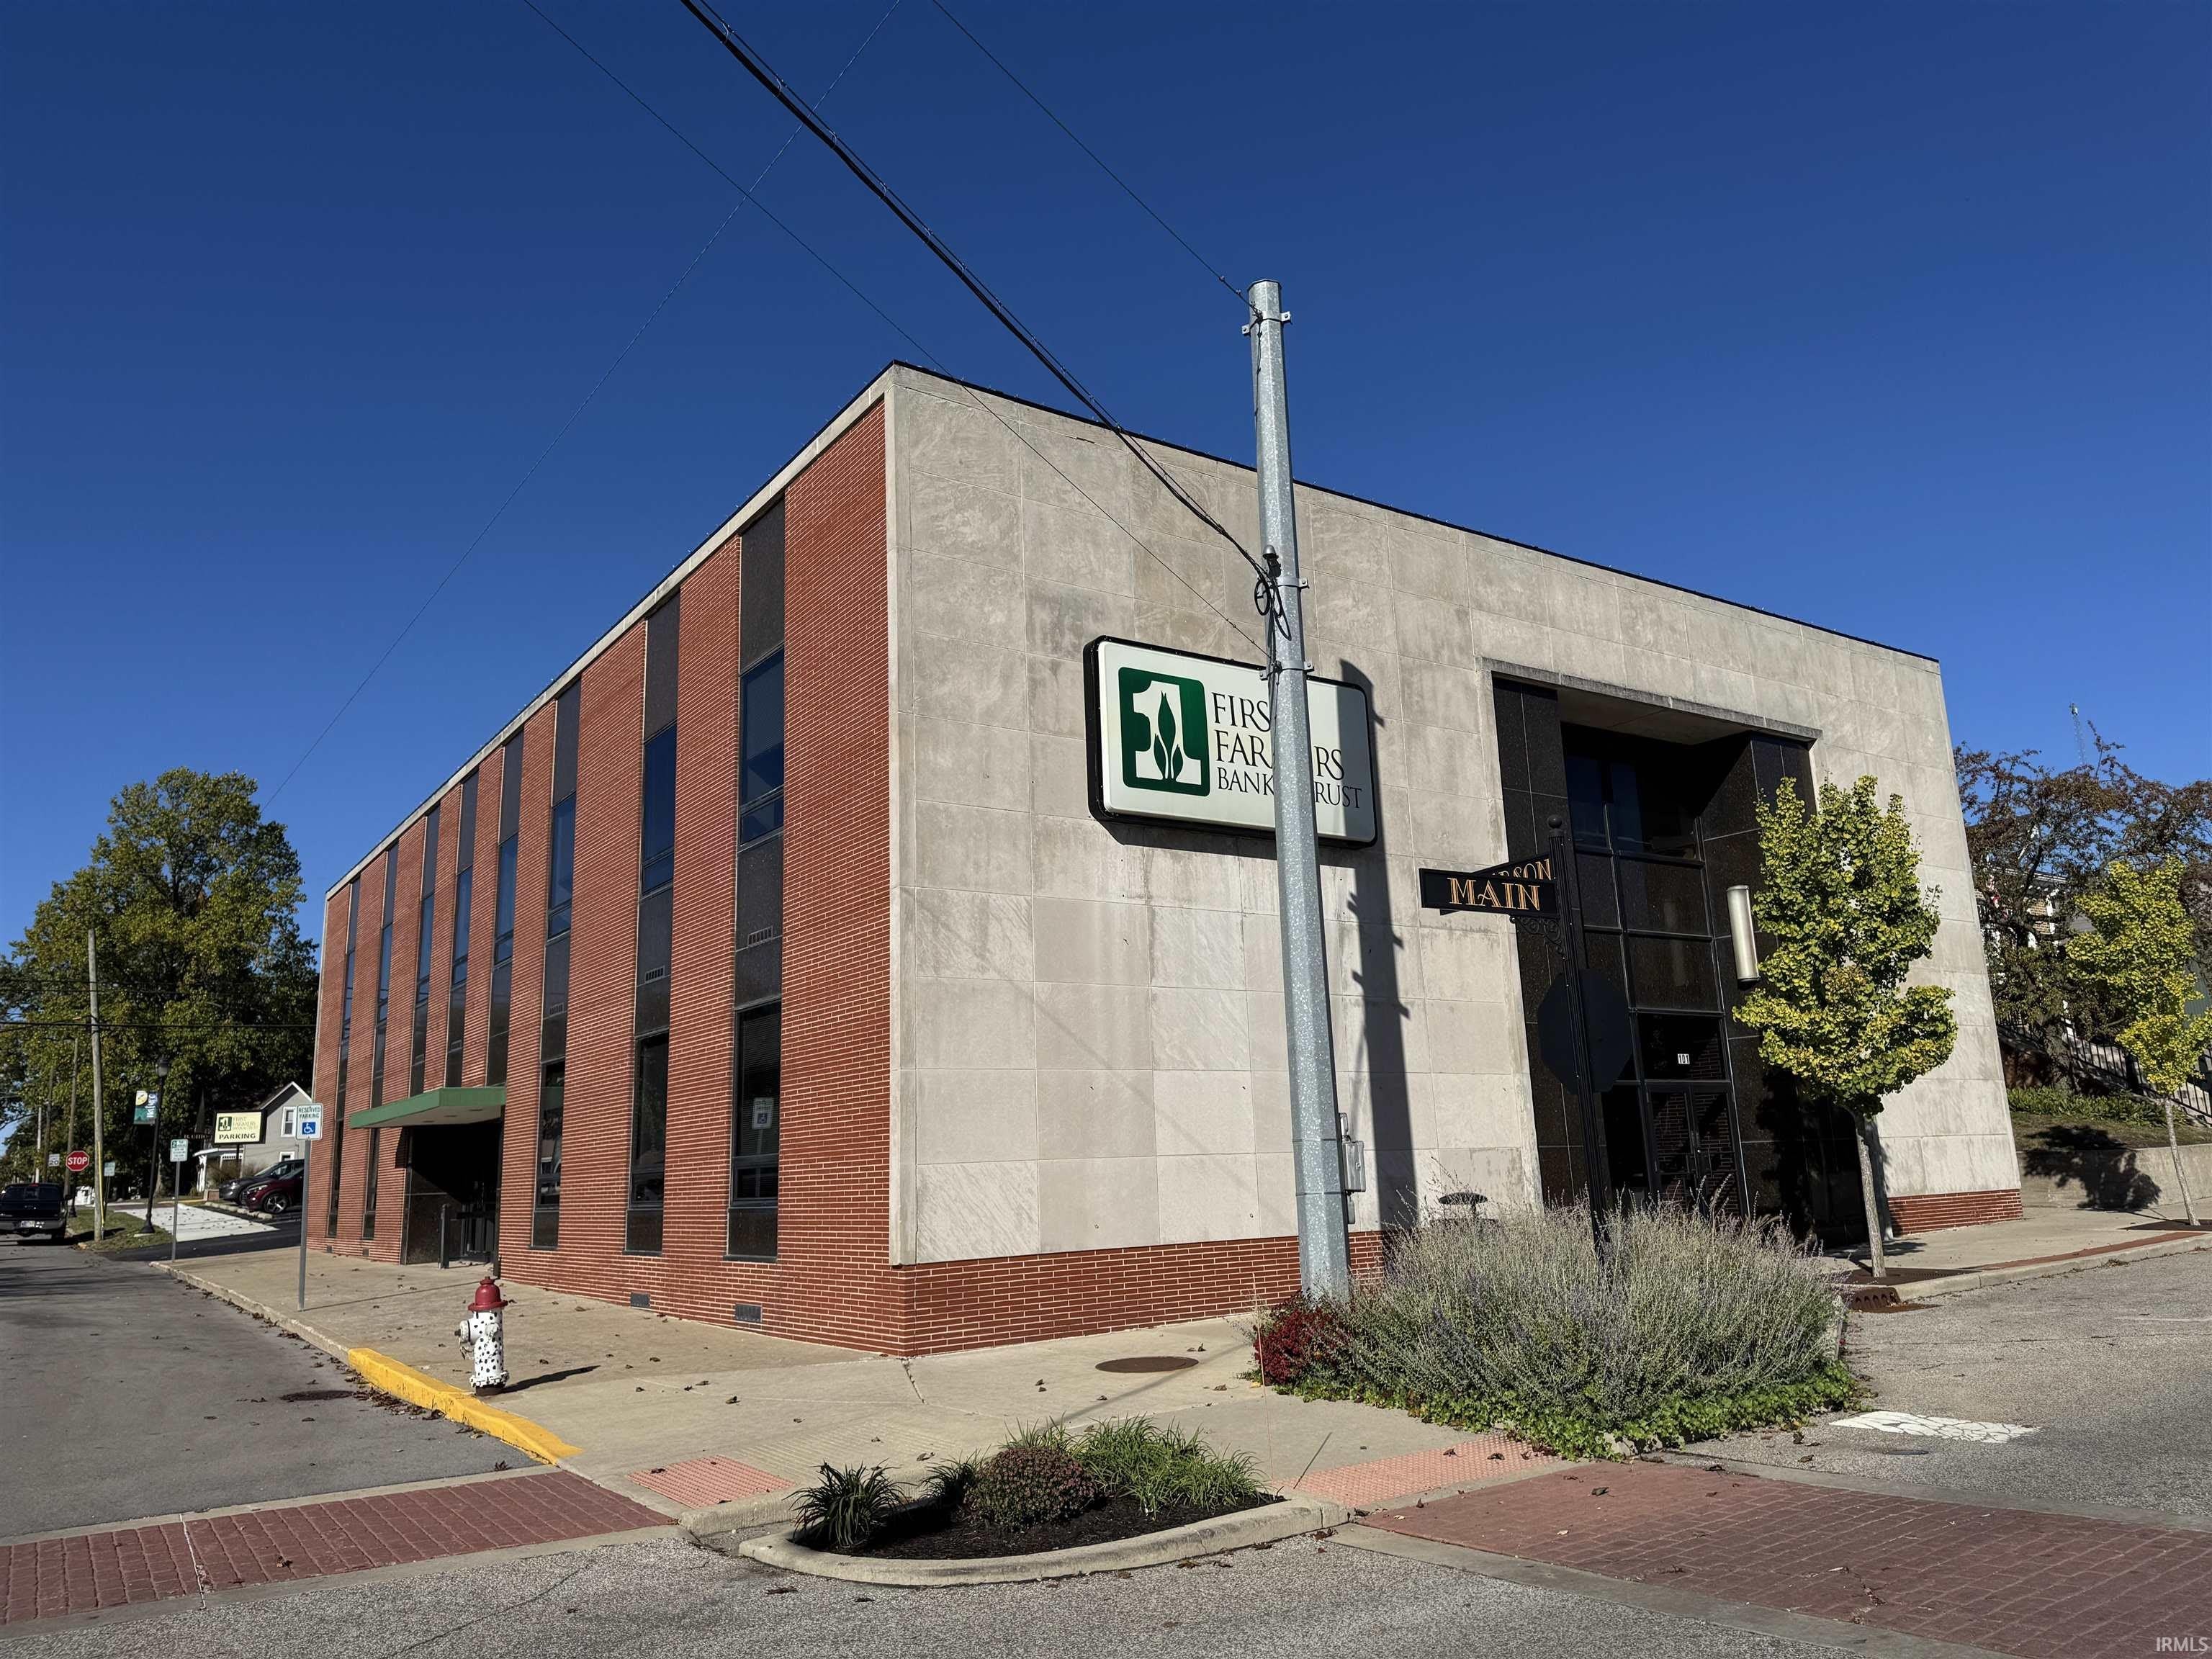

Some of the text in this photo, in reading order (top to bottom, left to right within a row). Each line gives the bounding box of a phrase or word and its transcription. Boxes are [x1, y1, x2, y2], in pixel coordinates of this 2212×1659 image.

[1212, 692, 1271, 732] FIRS
[1214, 729, 1344, 781] FARRS
[1313, 781, 1362, 809] RUST
[1447, 877, 1540, 911] MAIN
[68, 1156, 88, 1165] STOP
